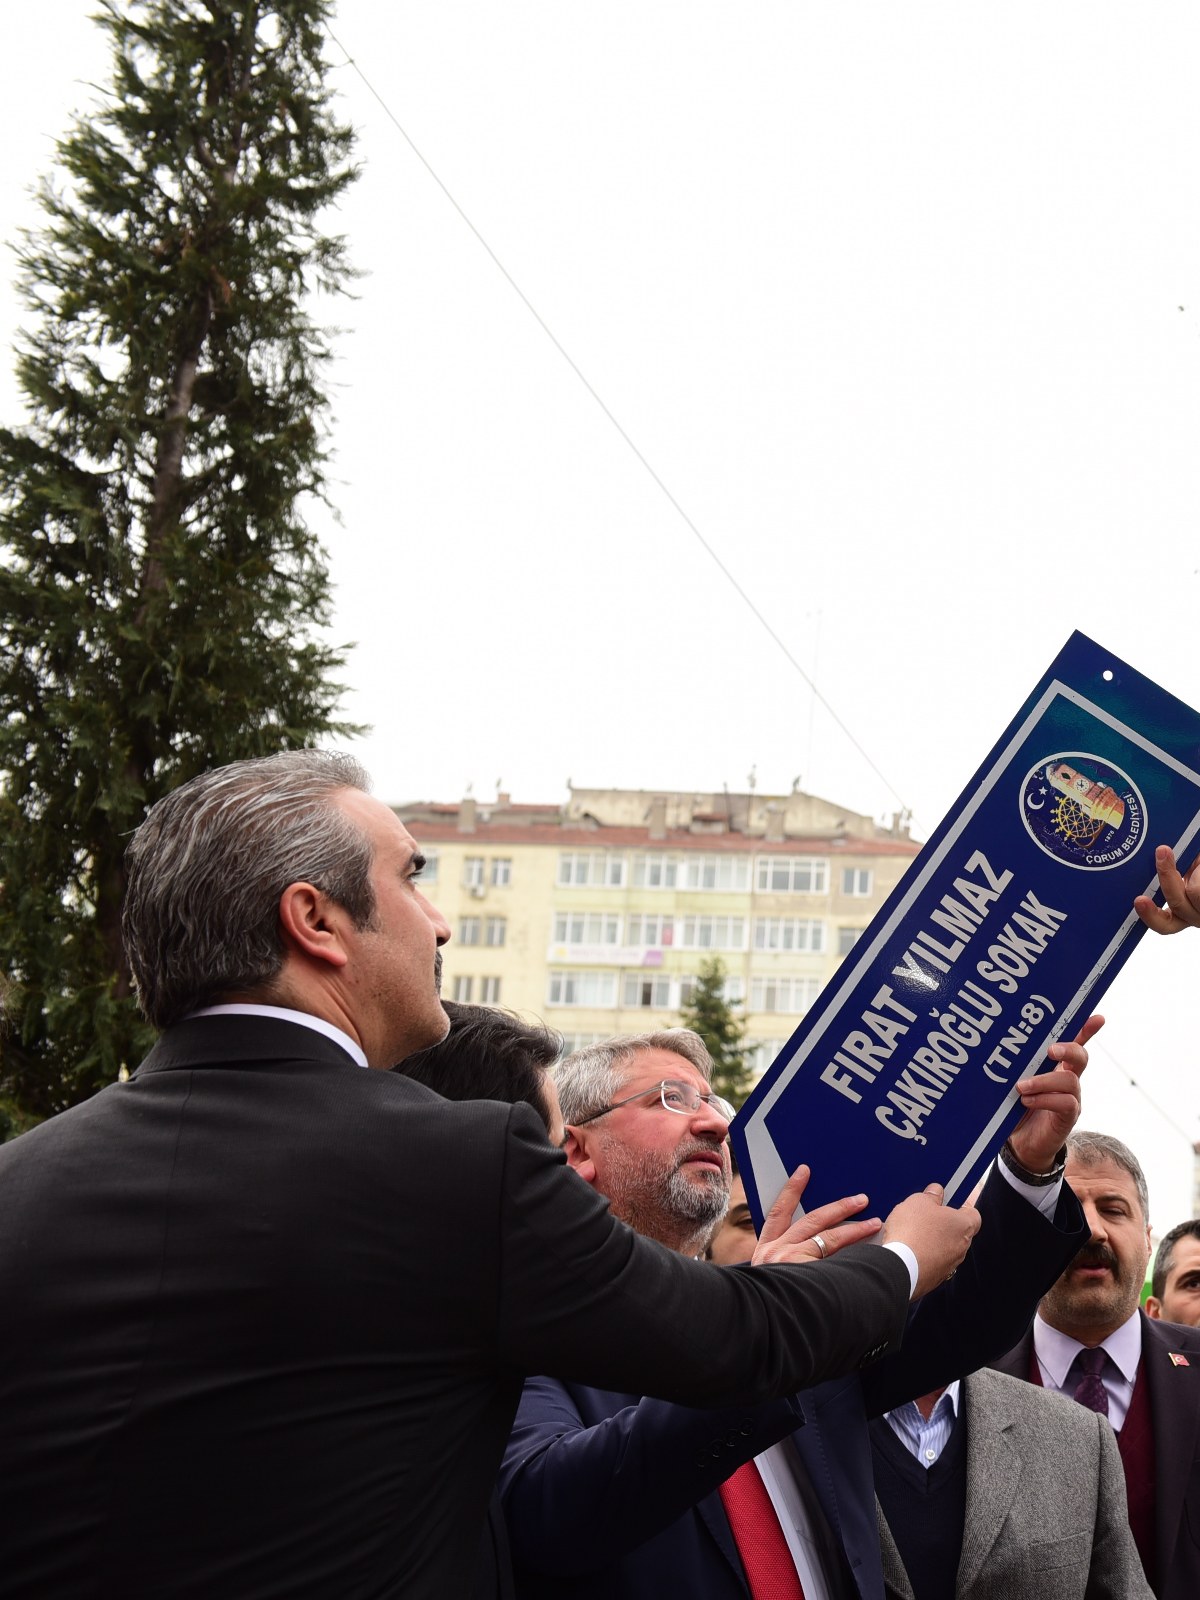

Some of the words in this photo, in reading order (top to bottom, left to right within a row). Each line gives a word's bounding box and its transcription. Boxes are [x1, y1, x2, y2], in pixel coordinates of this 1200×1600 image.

[1085, 847, 1124, 865] ÇORUM
[1121, 793, 1140, 851] BELEDİYESİ
[819, 983, 918, 1104] FIRAT
[891, 849, 1015, 991] YILMAZ
[874, 979, 1003, 1146] ÇAKIROĞLU
[976, 889, 1068, 994] SOKAK
[982, 994, 1056, 1084] (TN:8)
